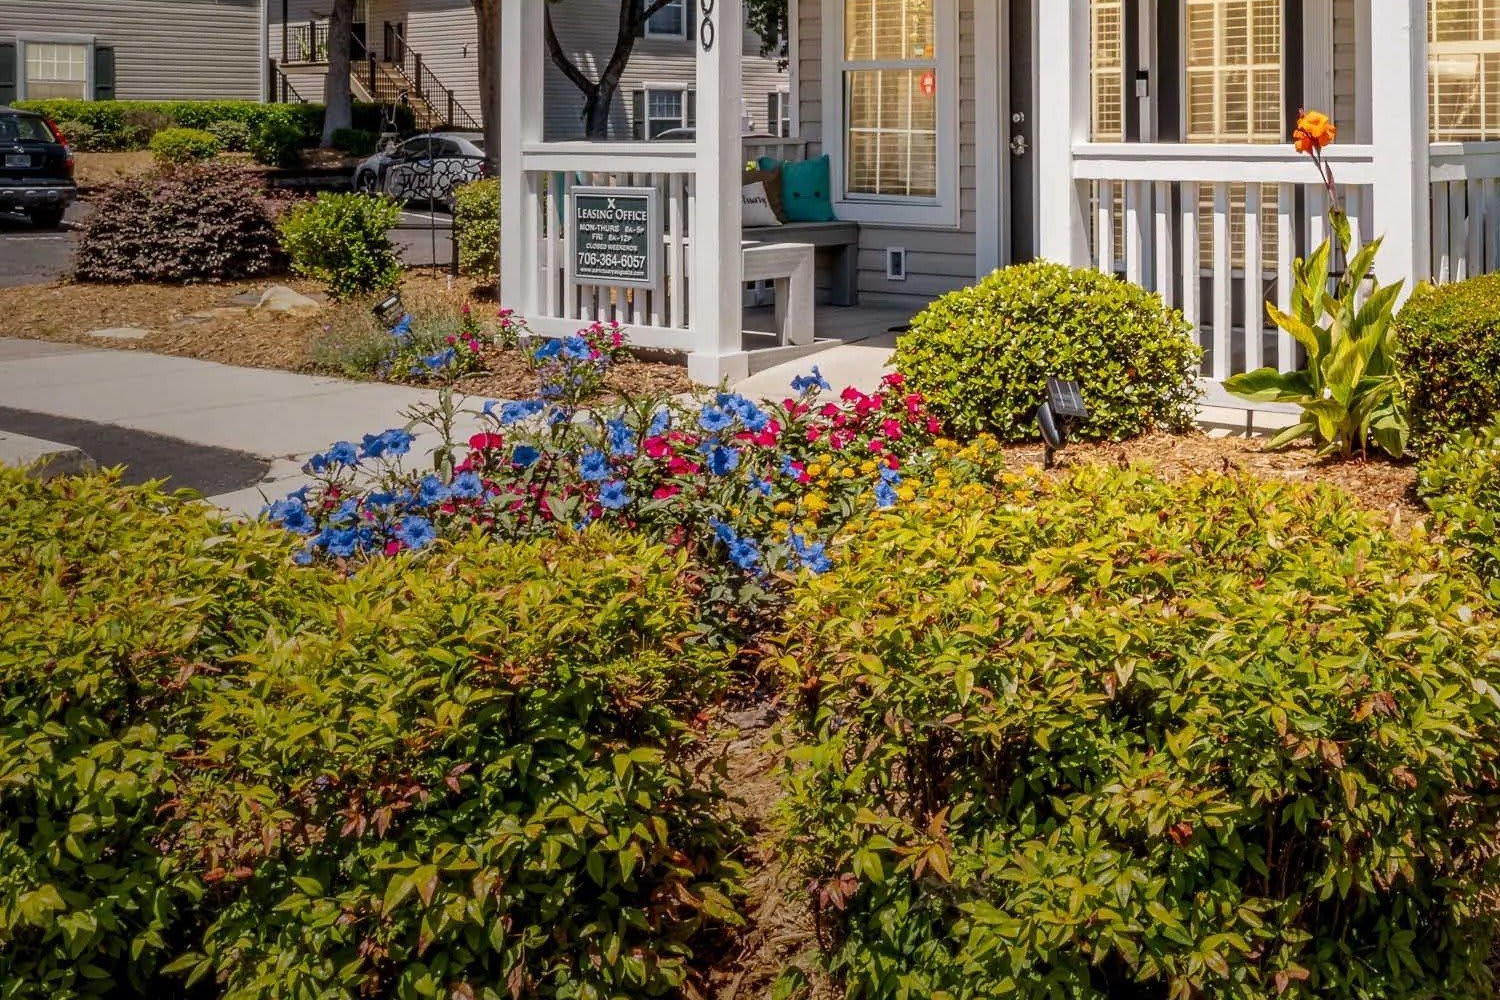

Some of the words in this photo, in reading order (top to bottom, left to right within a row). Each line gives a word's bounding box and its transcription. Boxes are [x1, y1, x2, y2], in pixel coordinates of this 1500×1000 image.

[578, 208, 613, 219] LEASING
[615, 209, 647, 221] OFFICE
[580, 224, 619, 232] MON-THURS
[592, 233, 603, 241] FRI
[578, 252, 646, 268] 706-364-6057
